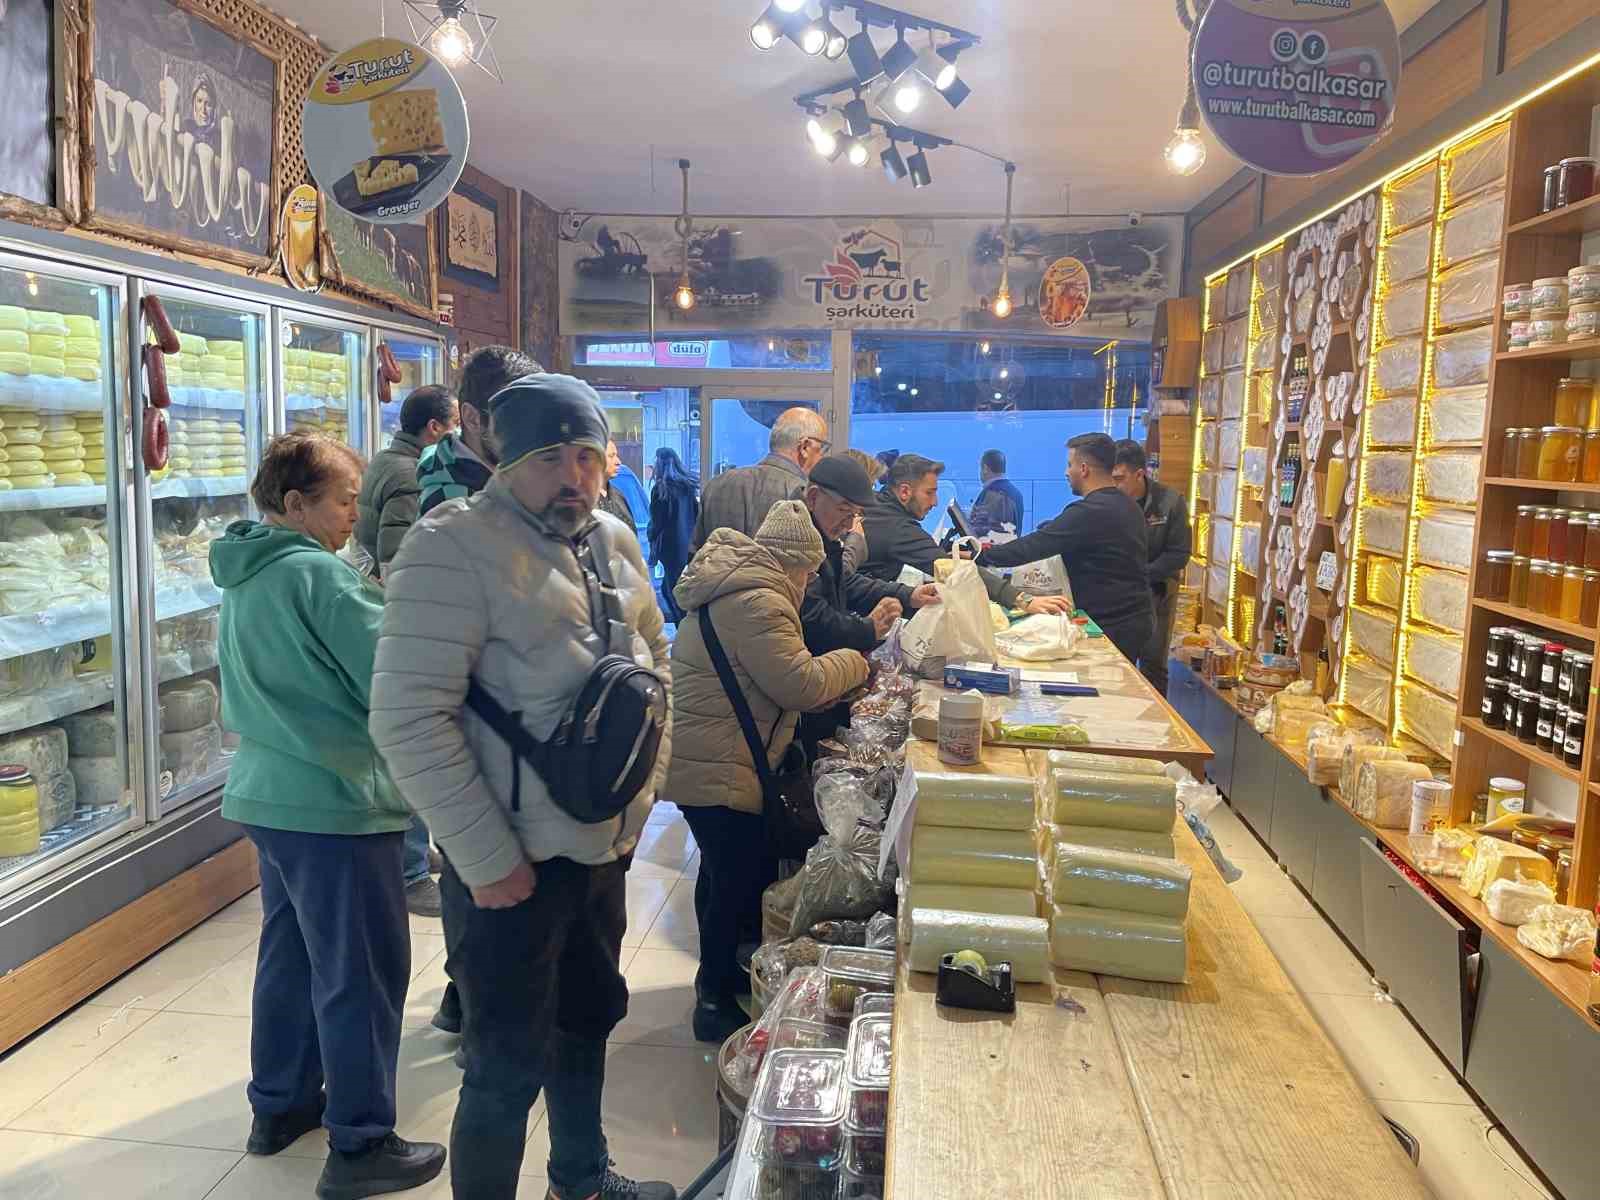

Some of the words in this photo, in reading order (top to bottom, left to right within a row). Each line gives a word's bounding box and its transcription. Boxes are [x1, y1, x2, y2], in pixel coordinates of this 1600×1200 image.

[351, 49, 414, 79] Turut
[1203, 62, 1386, 99] @turutbalkasar
[1208, 98, 1376, 127] www.turutbalkasar.com
[377, 200, 420, 217] Gravyer
[804, 278, 929, 303] Turut
[826, 304, 915, 320] şarküteri
